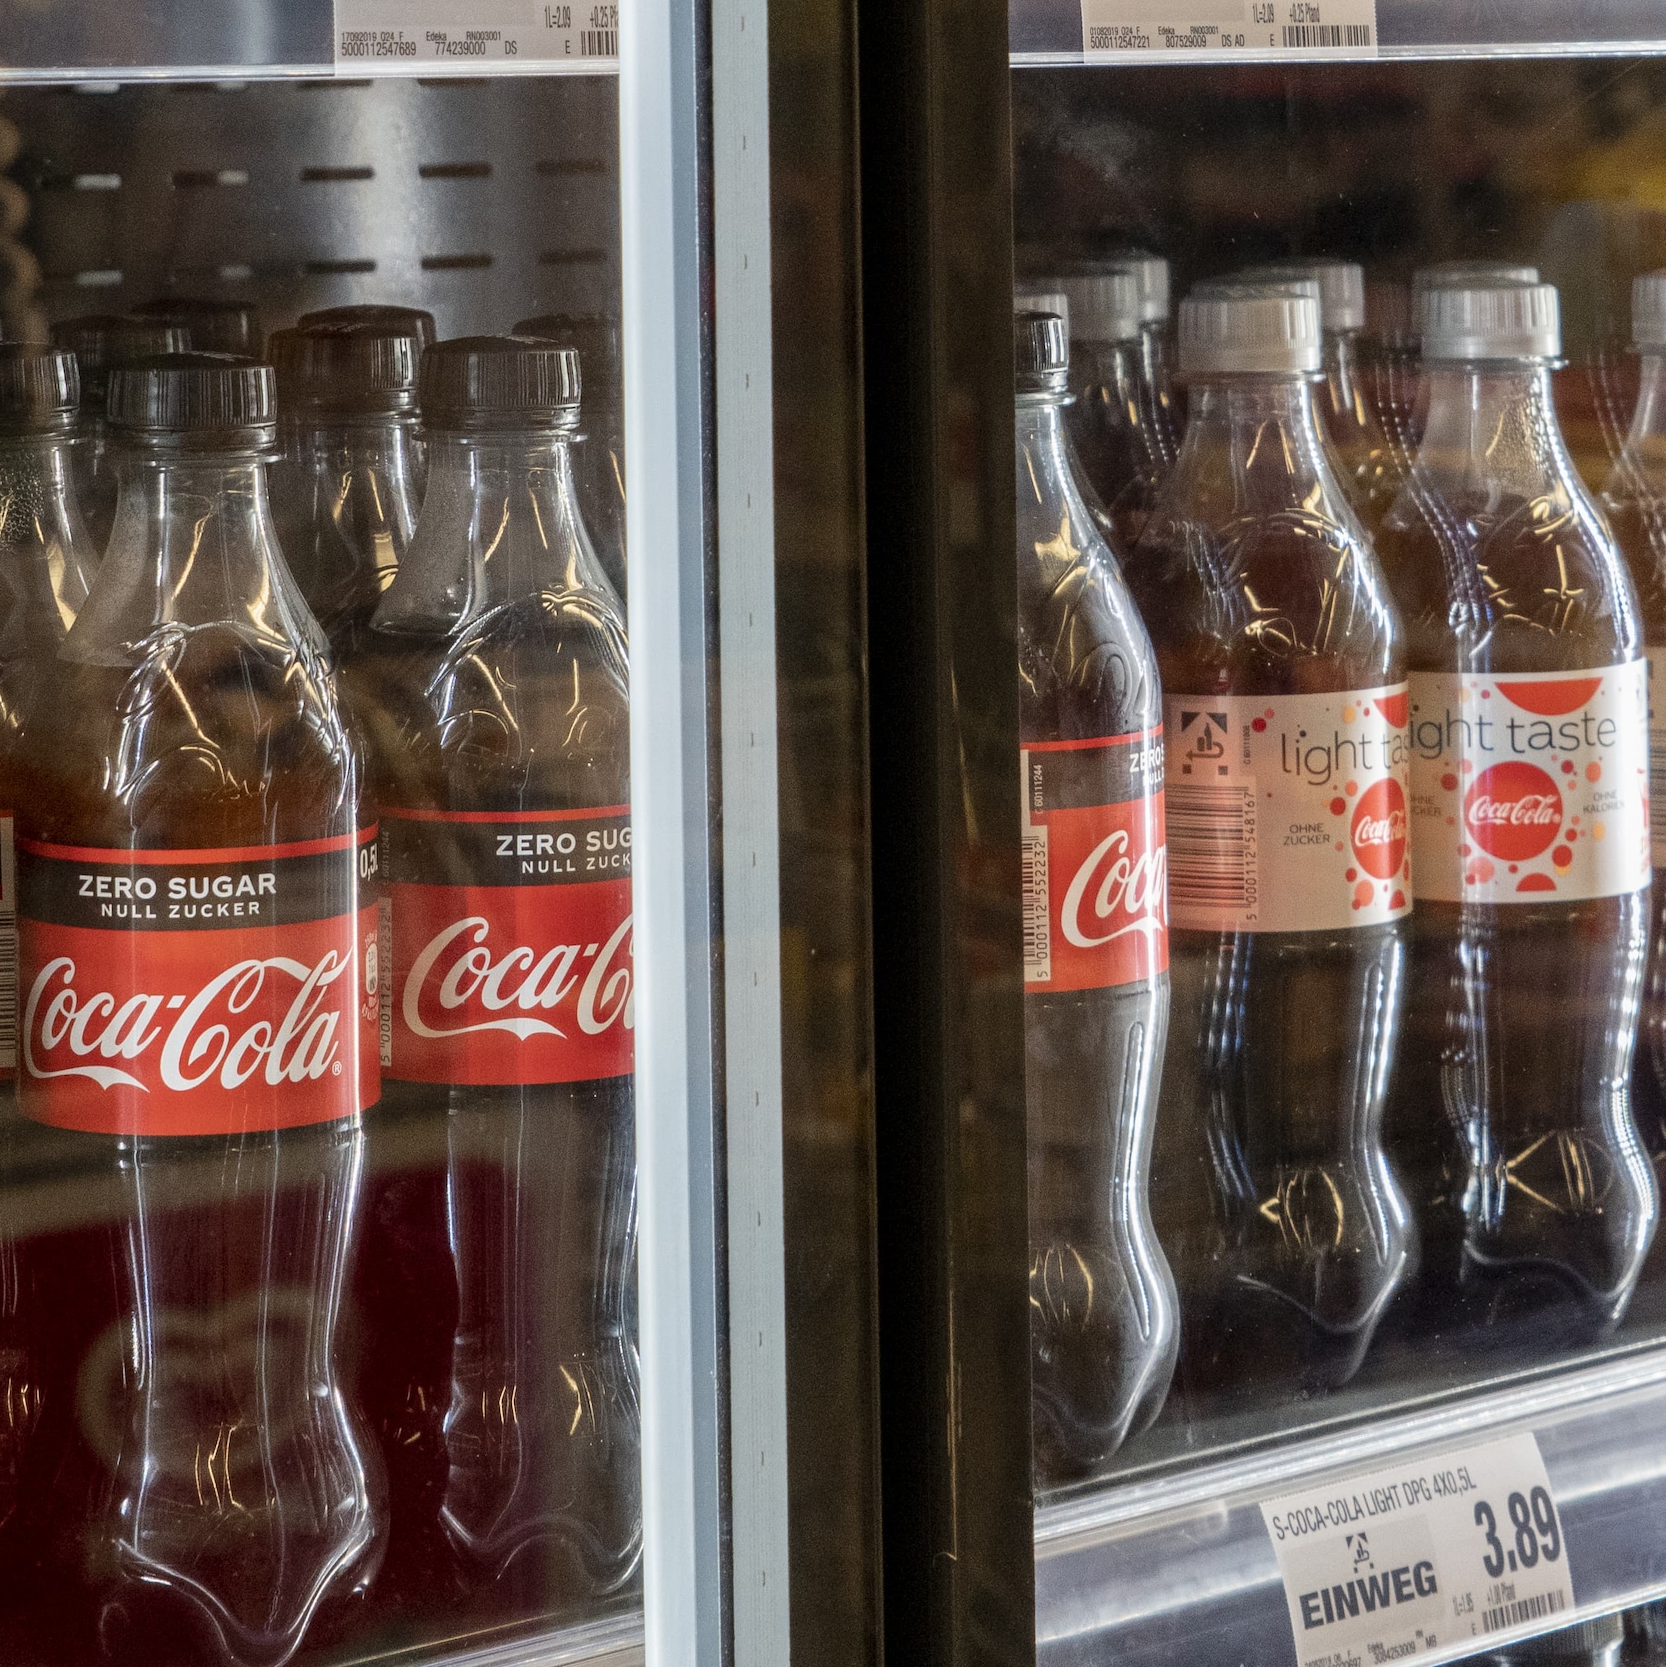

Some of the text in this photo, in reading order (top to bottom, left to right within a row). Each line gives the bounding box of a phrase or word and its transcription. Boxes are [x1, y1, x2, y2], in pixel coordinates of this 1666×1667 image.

[544, 5, 609, 29] 1L=2.09 +0.25
[1305, 2, 1320, 23] Pfand
[341, 32, 377, 42] 17092019
[426, 31, 447, 42] Edeka
[466, 32, 501, 41] RN003001
[341, 41, 517, 56] 5000112547689 774239000 DS
[1090, 35, 1245, 49] 5000112547221 807529009 DS AD
[1408, 705, 1618, 760] ight taste
[1280, 725, 1373, 786] light
[1468, 794, 1561, 826] Coca-Cola
[496, 826, 632, 856] ZERO SUG
[1283, 833, 1331, 846] ZUCKER
[1289, 822, 1325, 835] OHNE
[1244, 791, 1258, 906] 548167 000112
[521, 853, 631, 876] NULL ZUCK
[78, 872, 277, 900] ZERO SUGAR
[1034, 840, 1049, 960] 552232 000112
[1060, 828, 1169, 949] Coca
[100, 900, 261, 920] NULL ZUCKER
[24, 945, 355, 1094] Coca-Cola
[380, 983, 391, 1043] 000112
[1272, 1466, 1478, 1541] S-COCA-COLA LIGHT DPG 4X0,5L
[1473, 1484, 1562, 1579] 3.89
[1299, 1560, 1439, 1631] EINWEG
[1425, 1634, 1438, 1650] MB
